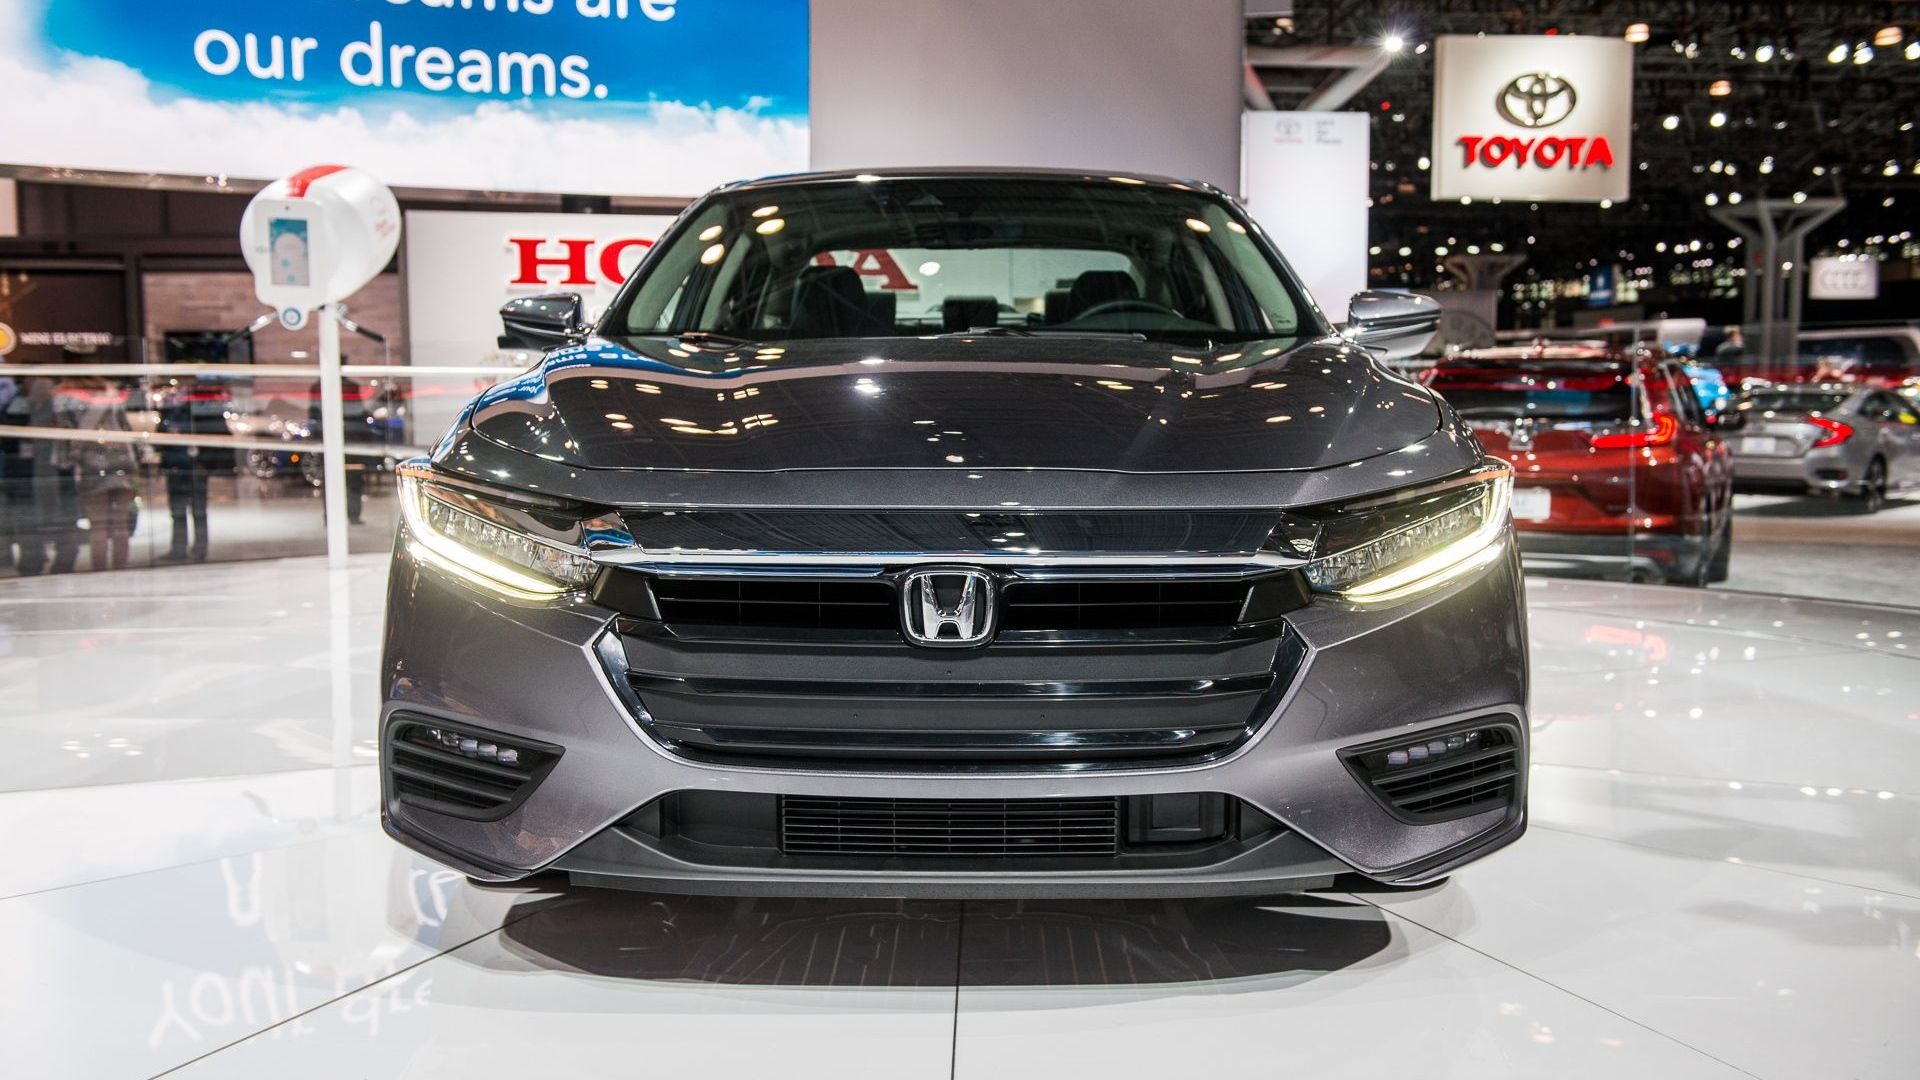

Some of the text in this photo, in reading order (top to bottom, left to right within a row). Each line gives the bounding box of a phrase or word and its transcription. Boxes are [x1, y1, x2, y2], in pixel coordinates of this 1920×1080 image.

[193, 20, 608, 99] our dreams.
[1457, 135, 1614, 168] TOYOTA
